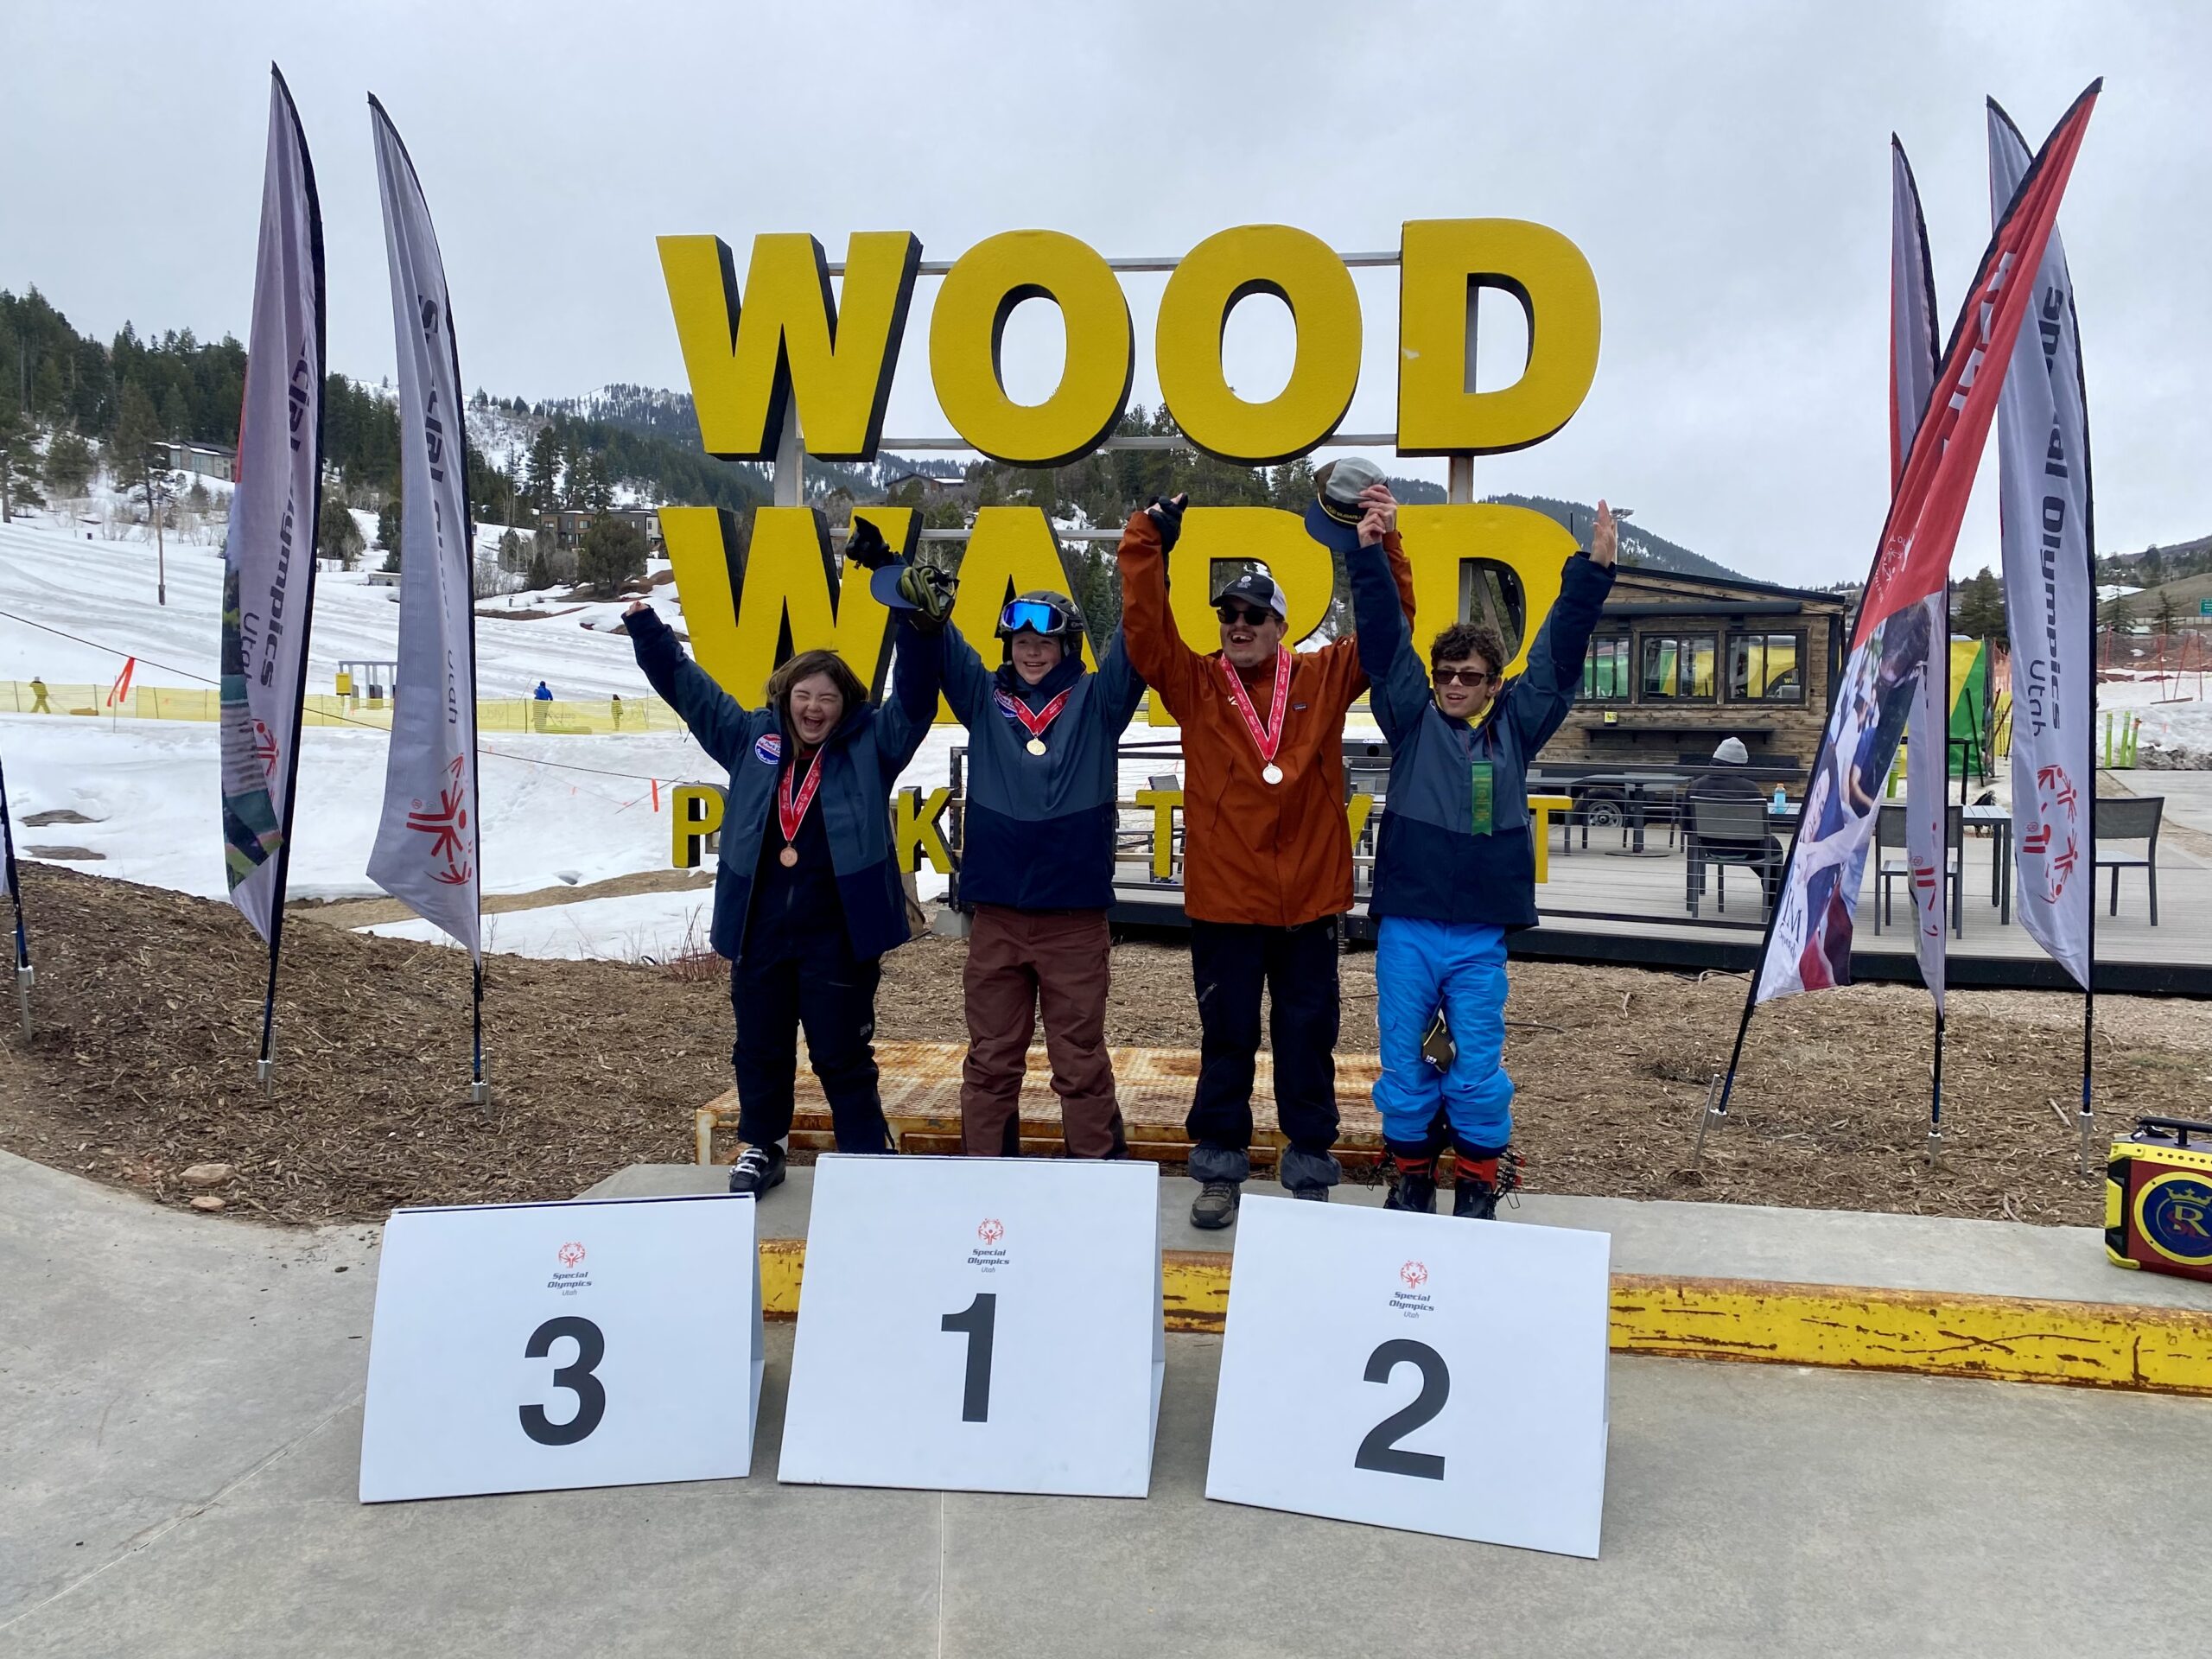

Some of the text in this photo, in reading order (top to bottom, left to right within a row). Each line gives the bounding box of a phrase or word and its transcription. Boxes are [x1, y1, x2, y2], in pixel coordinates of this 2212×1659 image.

[656, 219, 1602, 467] WOOD
[2039, 495, 2066, 730] Olympics
[2027, 659, 2047, 737] Utah
[546, 1281, 593, 1289] Olympics
[552, 1272, 588, 1281] Special
[967, 1257, 1010, 1266] Olympics
[1395, 1291, 1431, 1302] Special
[1389, 1300, 1435, 1312] Olympics
[518, 1316, 606, 1446] 3
[941, 1293, 996, 1422] 1
[1354, 1338, 1451, 1480] 2
